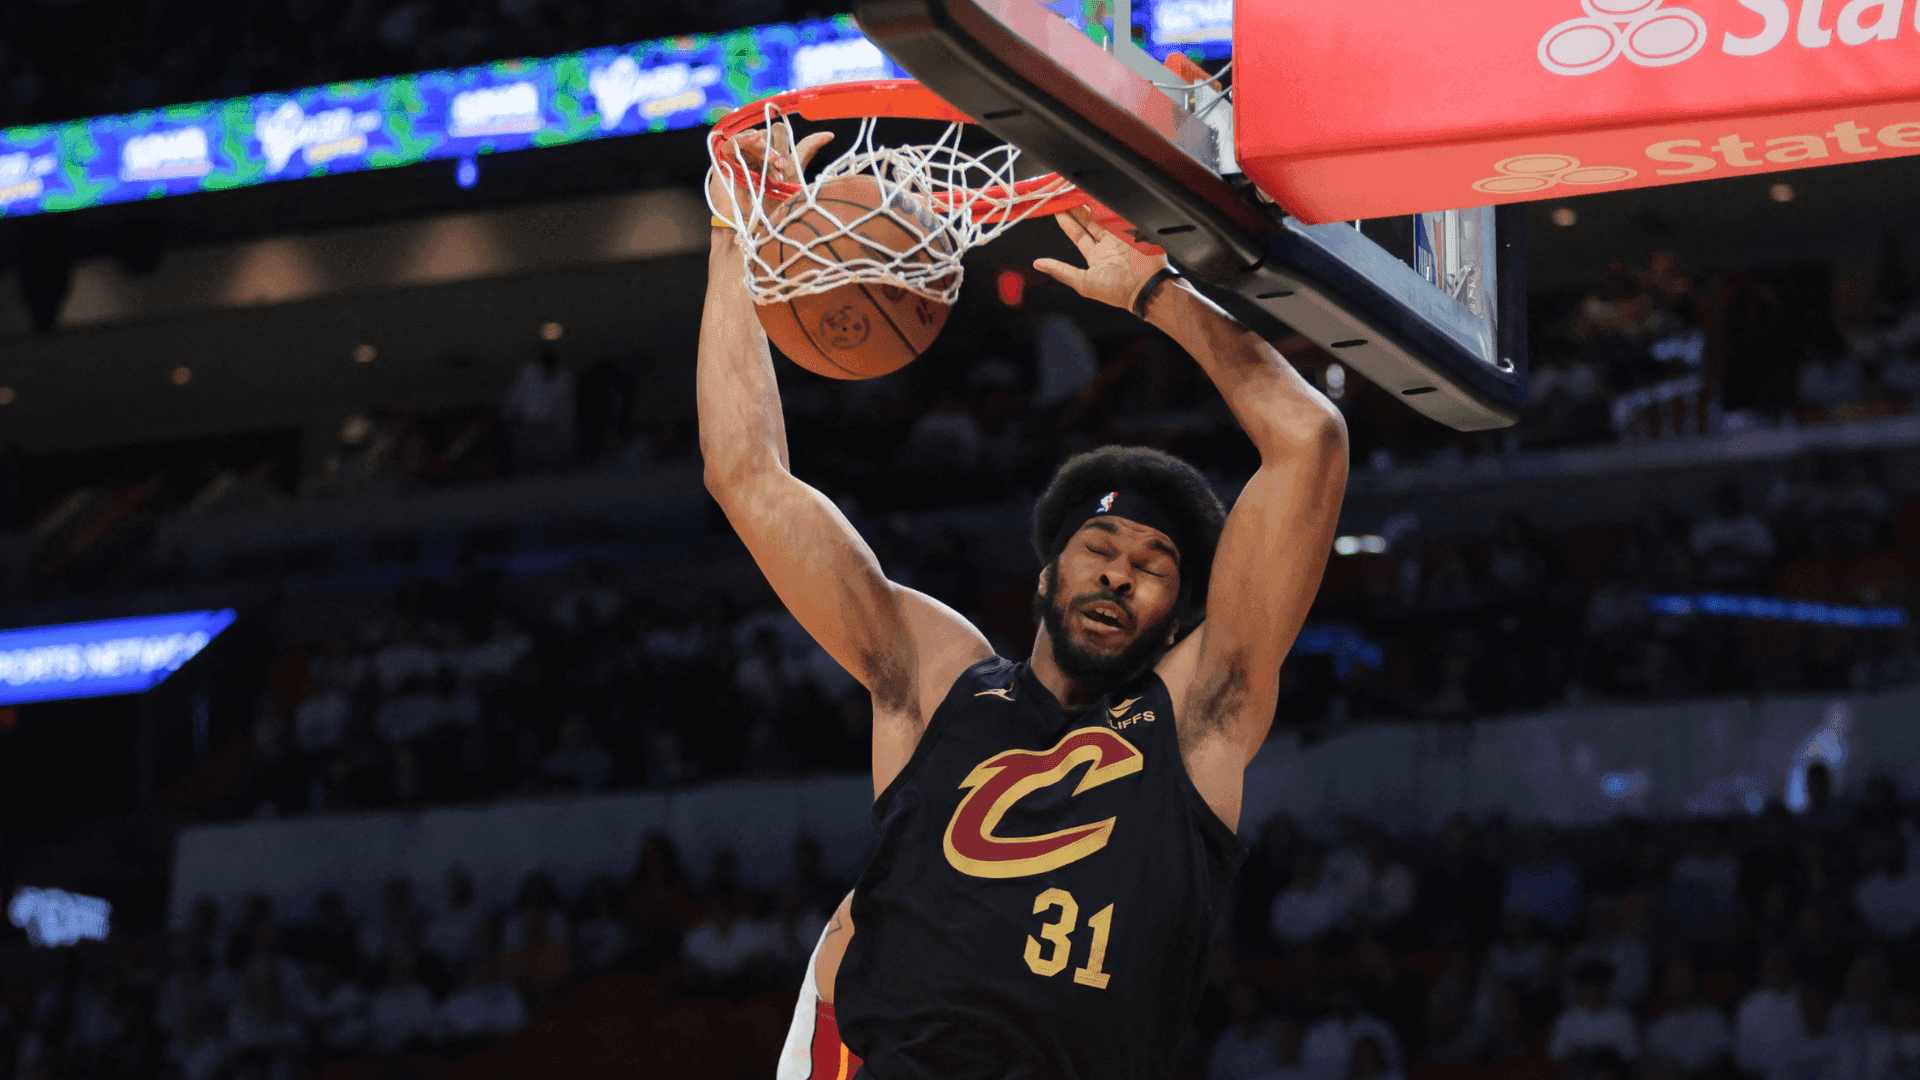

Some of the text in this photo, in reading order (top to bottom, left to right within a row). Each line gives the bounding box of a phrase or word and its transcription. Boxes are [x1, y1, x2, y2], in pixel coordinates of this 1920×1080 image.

[1645, 120, 1920, 176] State
[1105, 710, 1156, 730] LIFFS
[1023, 887, 1114, 989] 31
